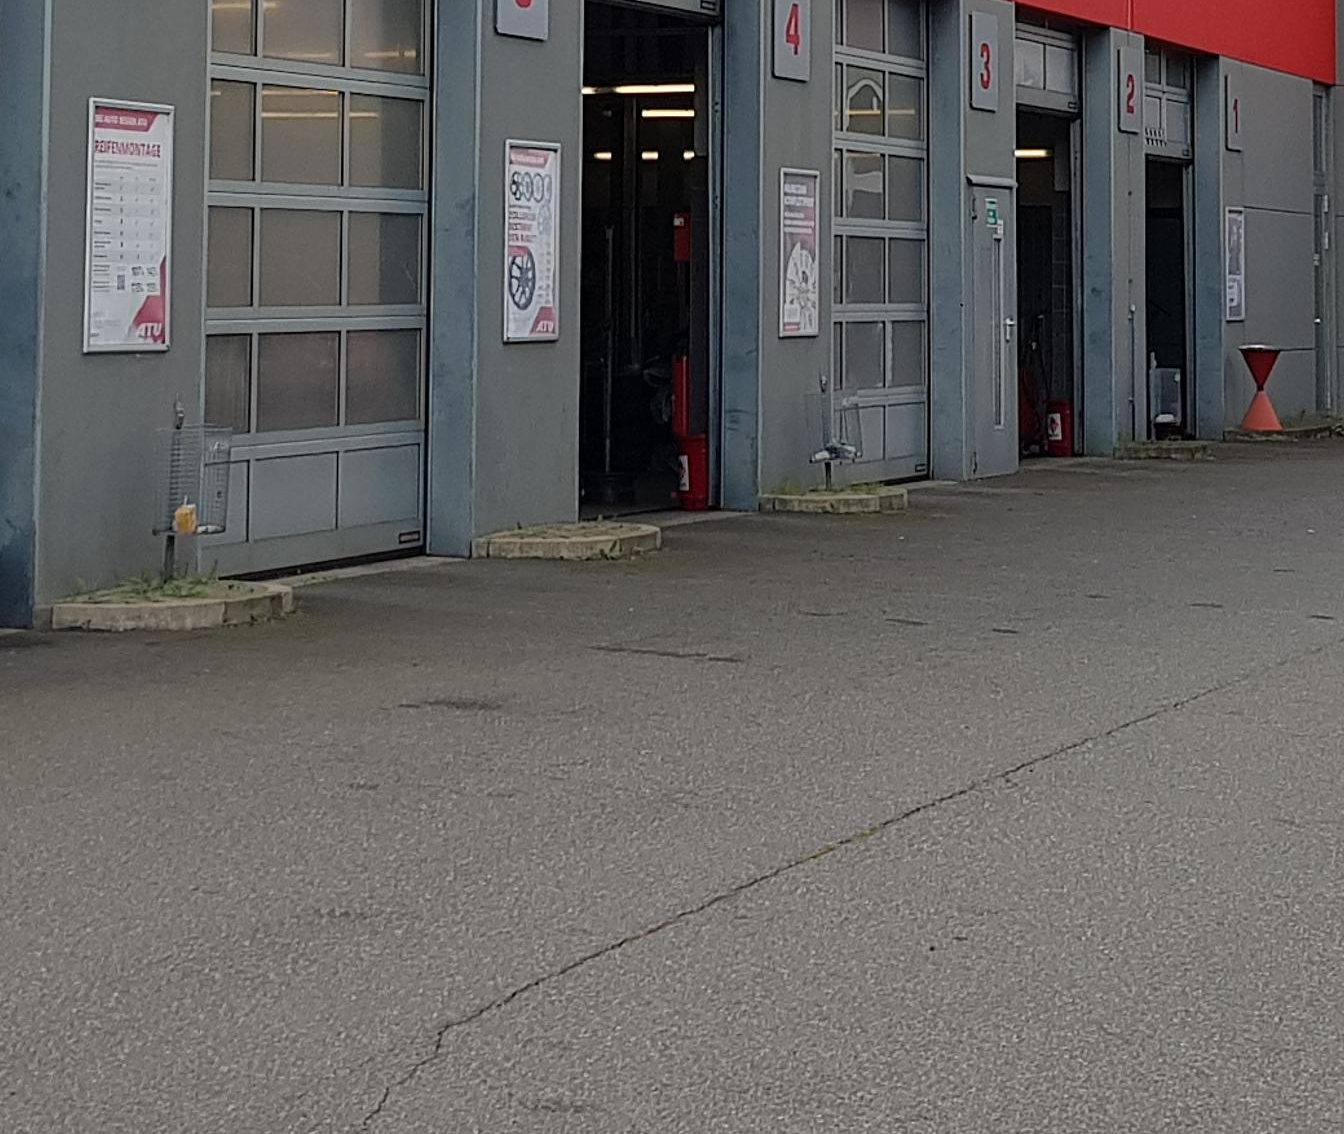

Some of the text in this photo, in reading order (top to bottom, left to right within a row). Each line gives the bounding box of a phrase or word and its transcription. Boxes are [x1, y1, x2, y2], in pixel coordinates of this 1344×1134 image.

[785, 3, 801, 55] 4
[979, 43, 991, 89] 3
[1126, 74, 1136, 114] 2
[1233, 99, 1239, 133] 1
[94, 139, 161, 159] REIFENMONTAGE
